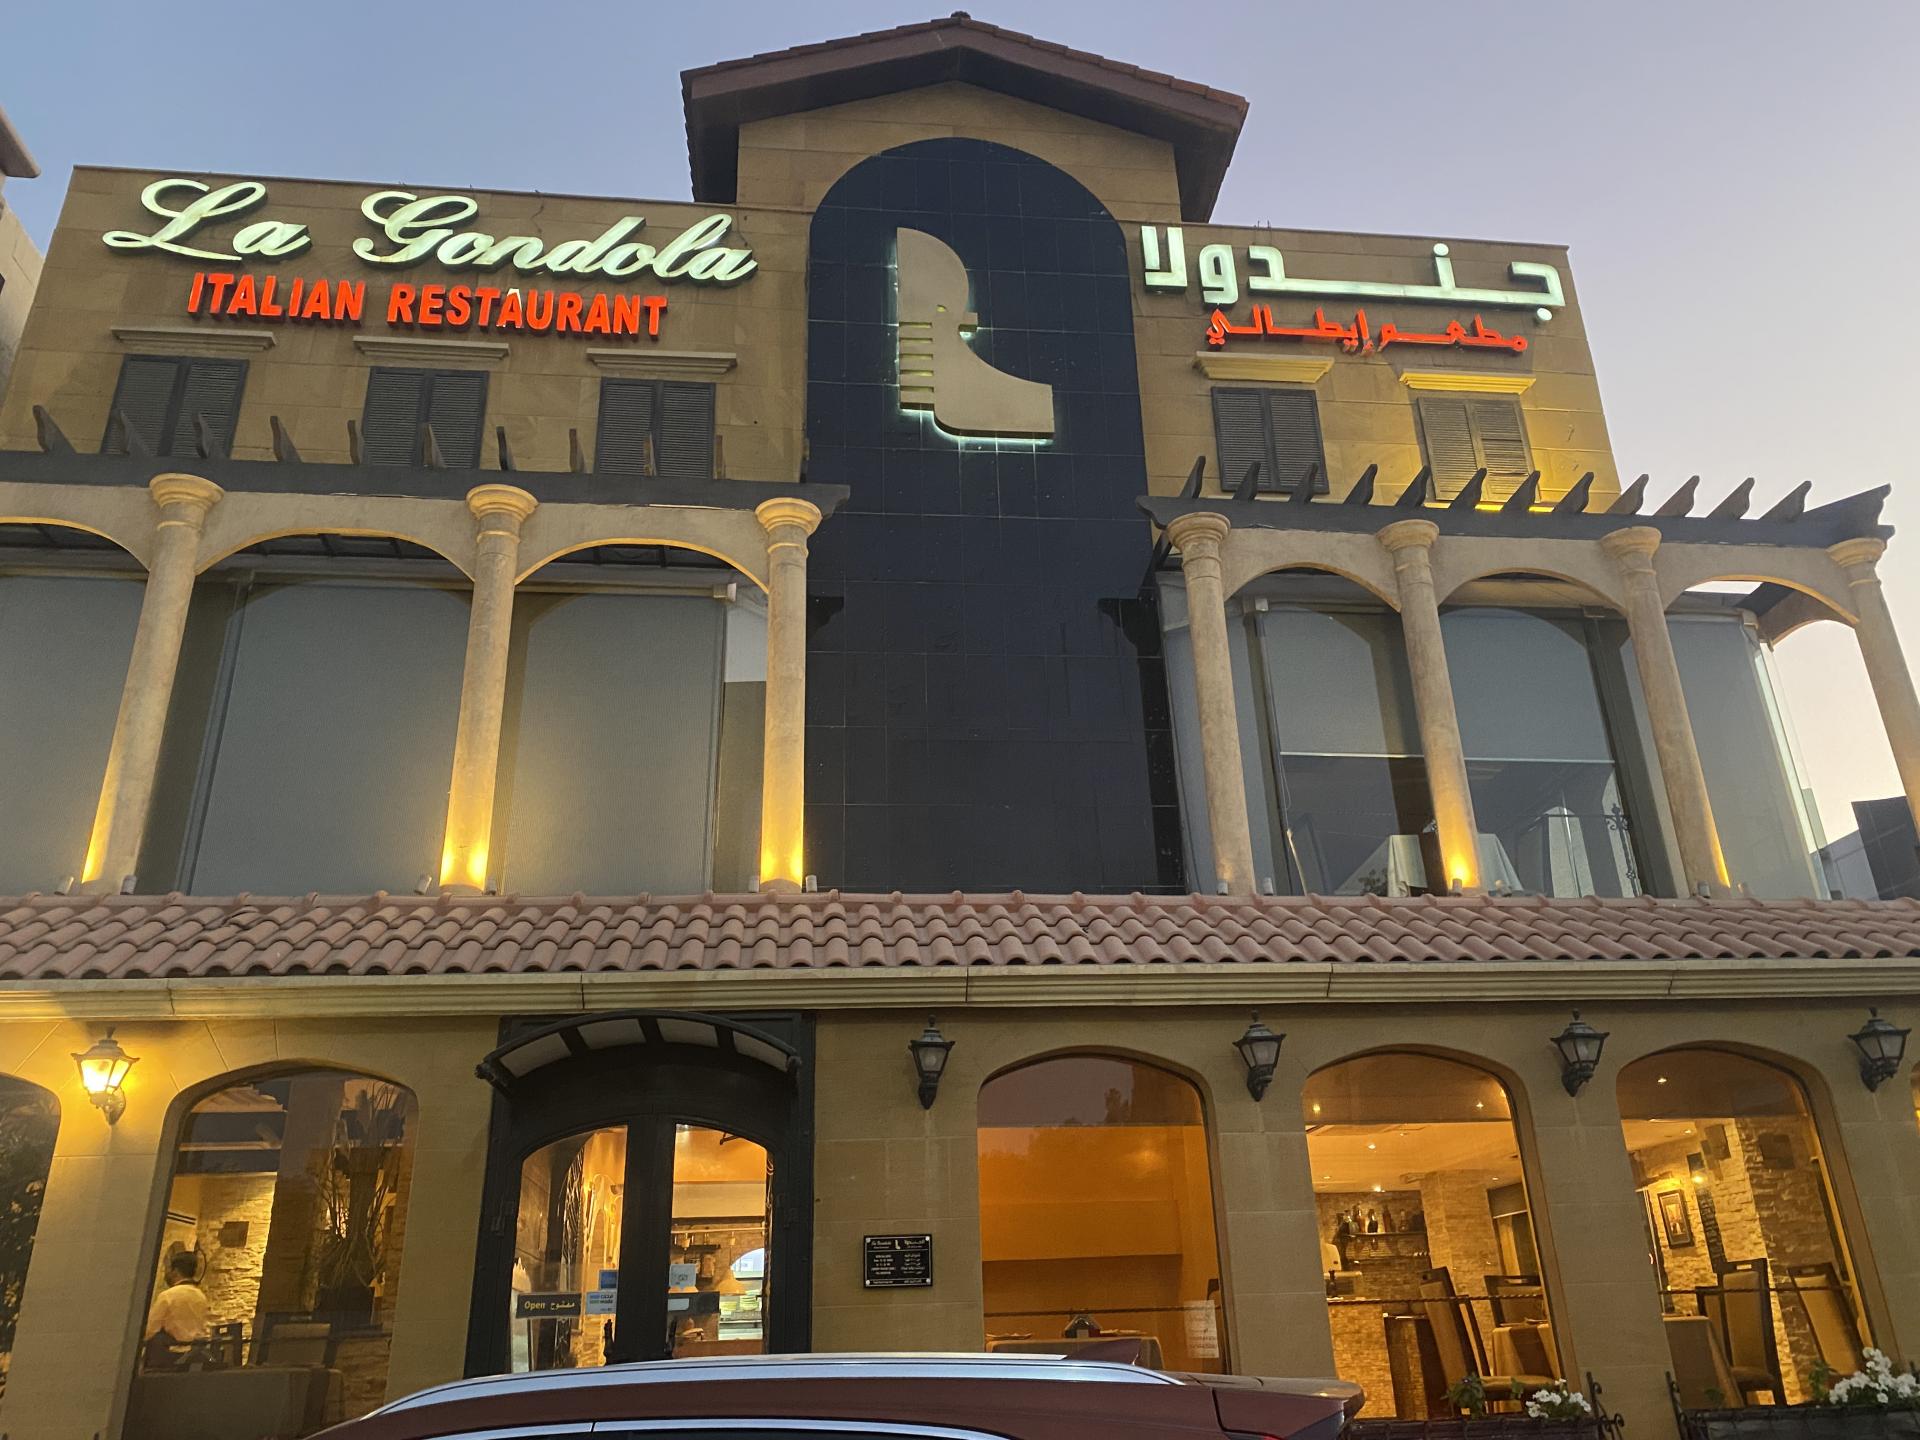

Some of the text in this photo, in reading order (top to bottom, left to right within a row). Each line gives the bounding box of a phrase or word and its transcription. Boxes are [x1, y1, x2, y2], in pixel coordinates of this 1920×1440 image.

[102, 179, 759, 281] La Gondola
[187, 272, 667, 335] ITALIAN RESTAURANT
[1377, 313, 1528, 352] مطعم
[524, 1300, 546, 1310] Open
